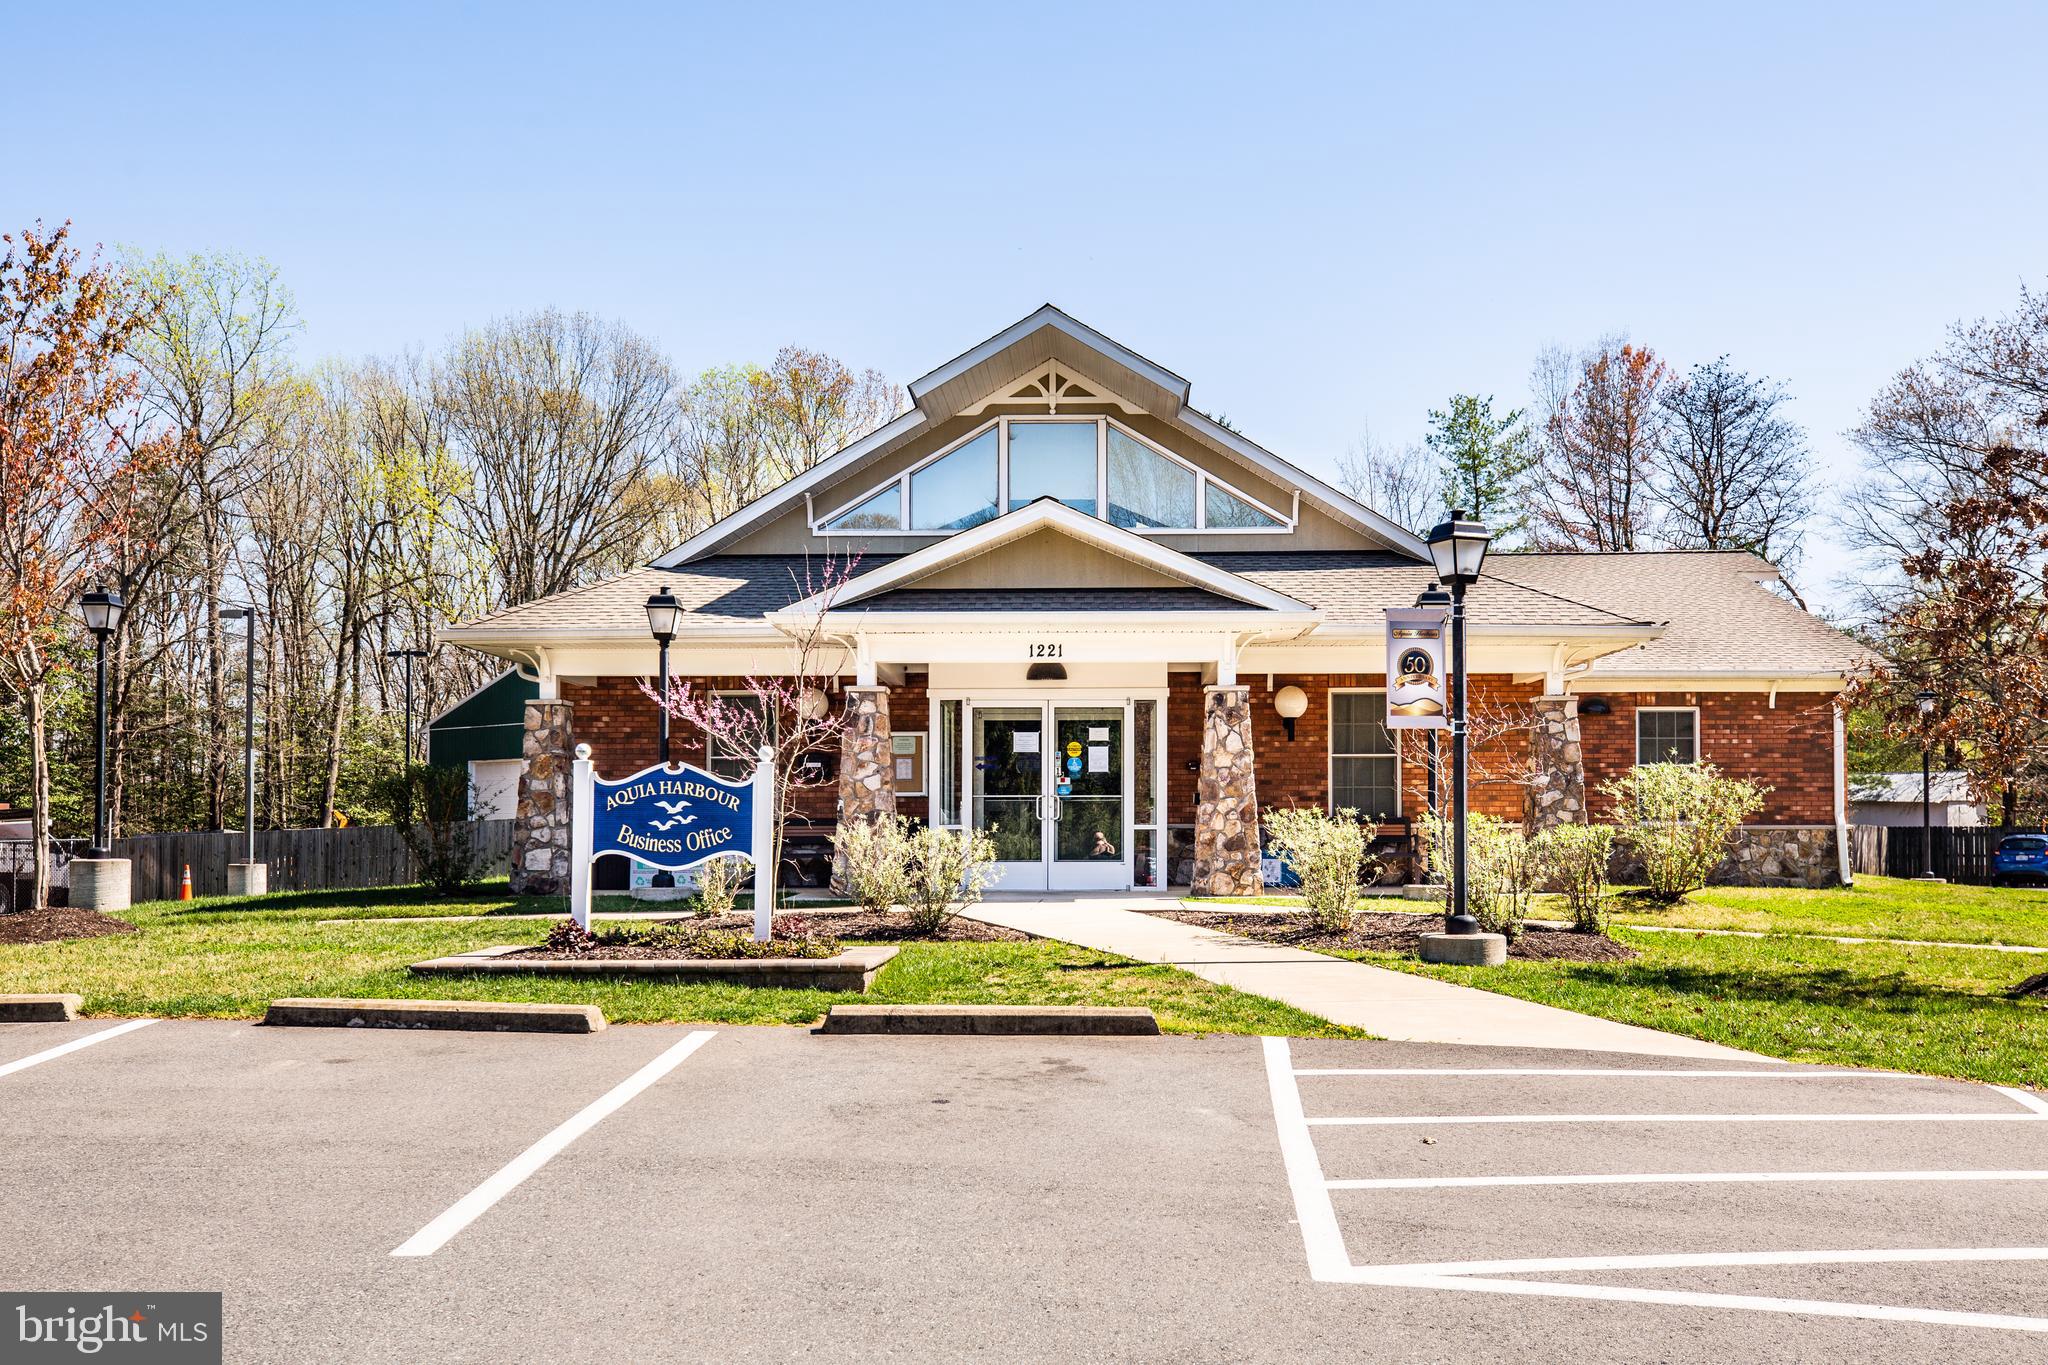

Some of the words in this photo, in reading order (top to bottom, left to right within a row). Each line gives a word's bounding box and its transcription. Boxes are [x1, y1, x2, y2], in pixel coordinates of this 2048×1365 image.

[1029, 643, 1063, 658] 1221
[1404, 656, 1426, 673] 50
[606, 782, 656, 811] AQUIA
[659, 781, 741, 812] HARBOUR
[616, 824, 682, 853] Business
[686, 826, 733, 851] Office
